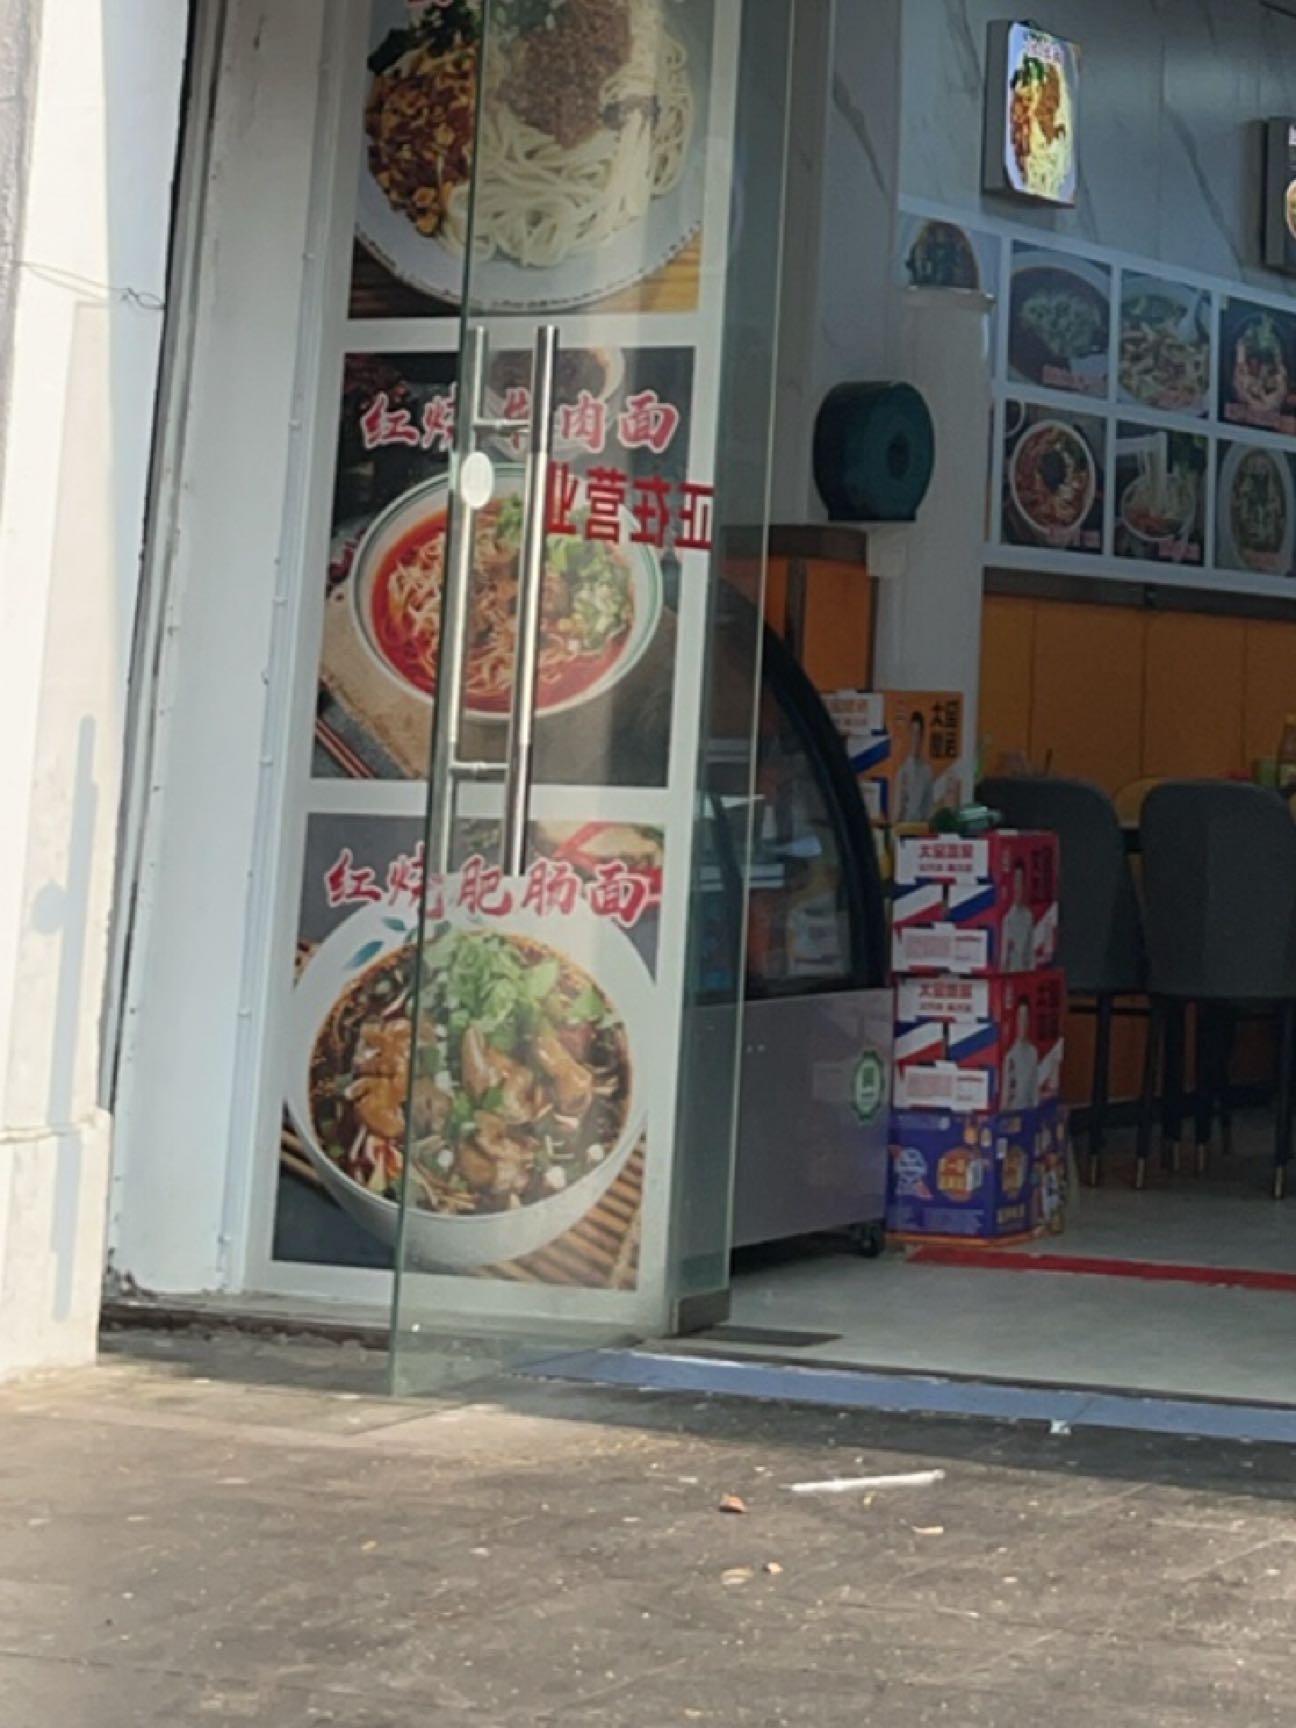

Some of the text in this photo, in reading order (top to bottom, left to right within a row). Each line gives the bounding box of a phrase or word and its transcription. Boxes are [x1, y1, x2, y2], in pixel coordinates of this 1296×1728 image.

[323, 841, 652, 928] 红烧肥肠面
